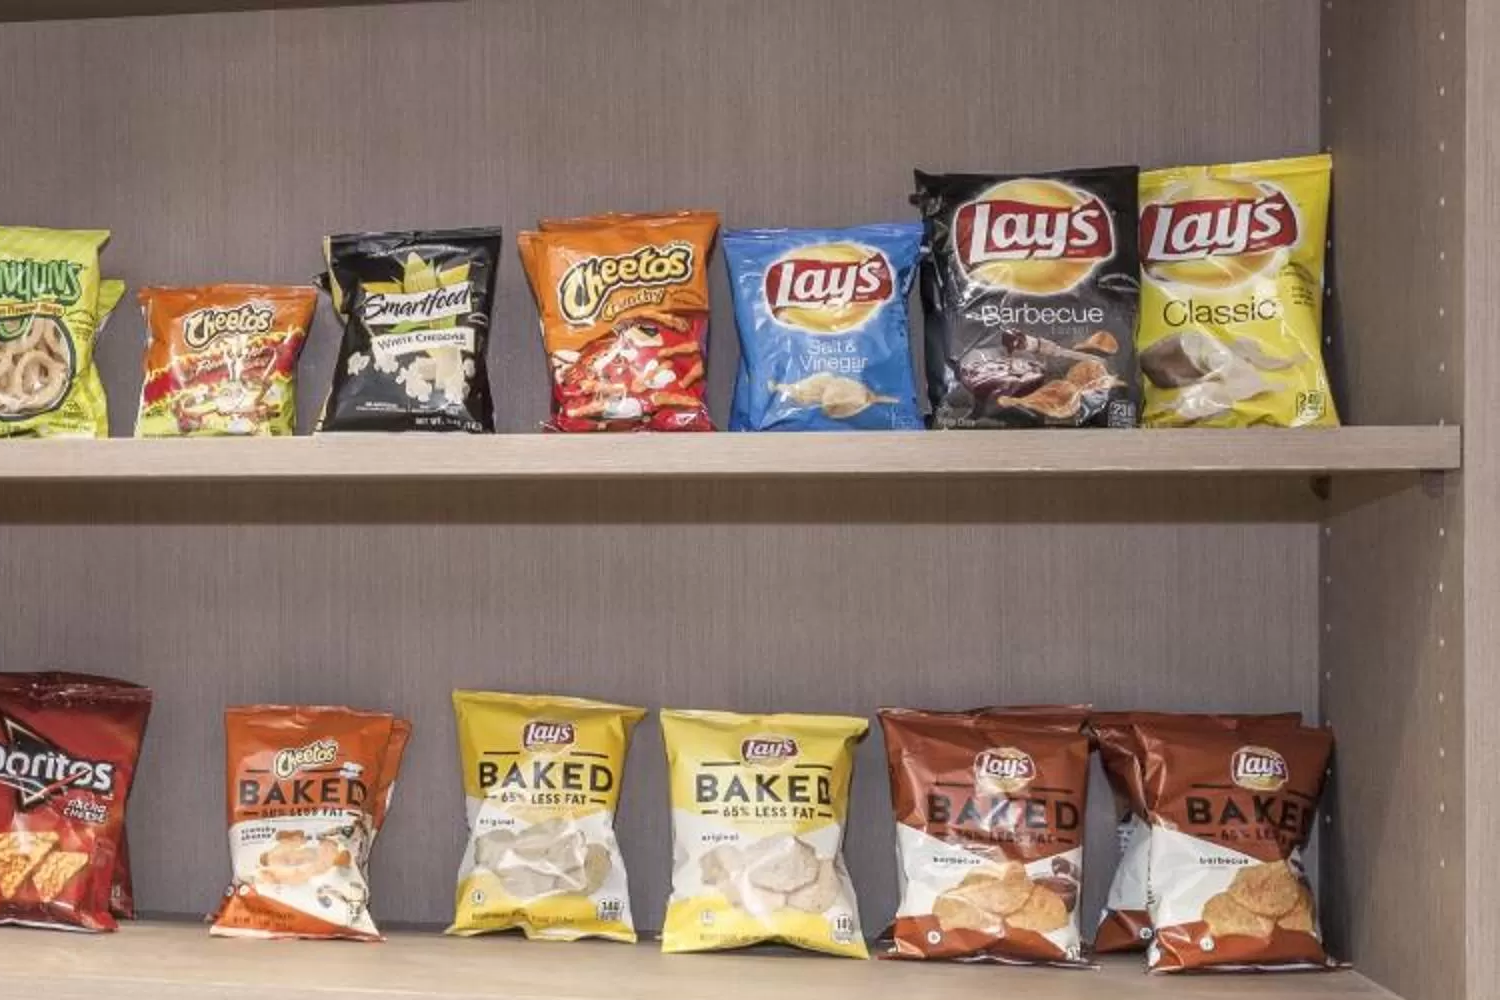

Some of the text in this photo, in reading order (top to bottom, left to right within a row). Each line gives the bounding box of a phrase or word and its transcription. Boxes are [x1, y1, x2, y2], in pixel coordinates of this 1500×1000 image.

[561, 246, 691, 320] Cheetos
[358, 286, 469, 321] Smartfood
[980, 303, 1105, 325] Barbecue
[1163, 296, 1278, 327] Classic
[186, 304, 274, 347] Cheetos
[800, 355, 869, 373] Vinegar
[275, 743, 337, 778] Cheetos
[479, 760, 614, 793] BAKED
[238, 777, 368, 807] BAKED
[531, 793, 561, 805] LESS
[563, 794, 587, 805] FAT
[695, 773, 832, 805] BAKED
[722, 806, 814, 819] 65% LESS FAT
[927, 793, 1079, 830] BAKED
